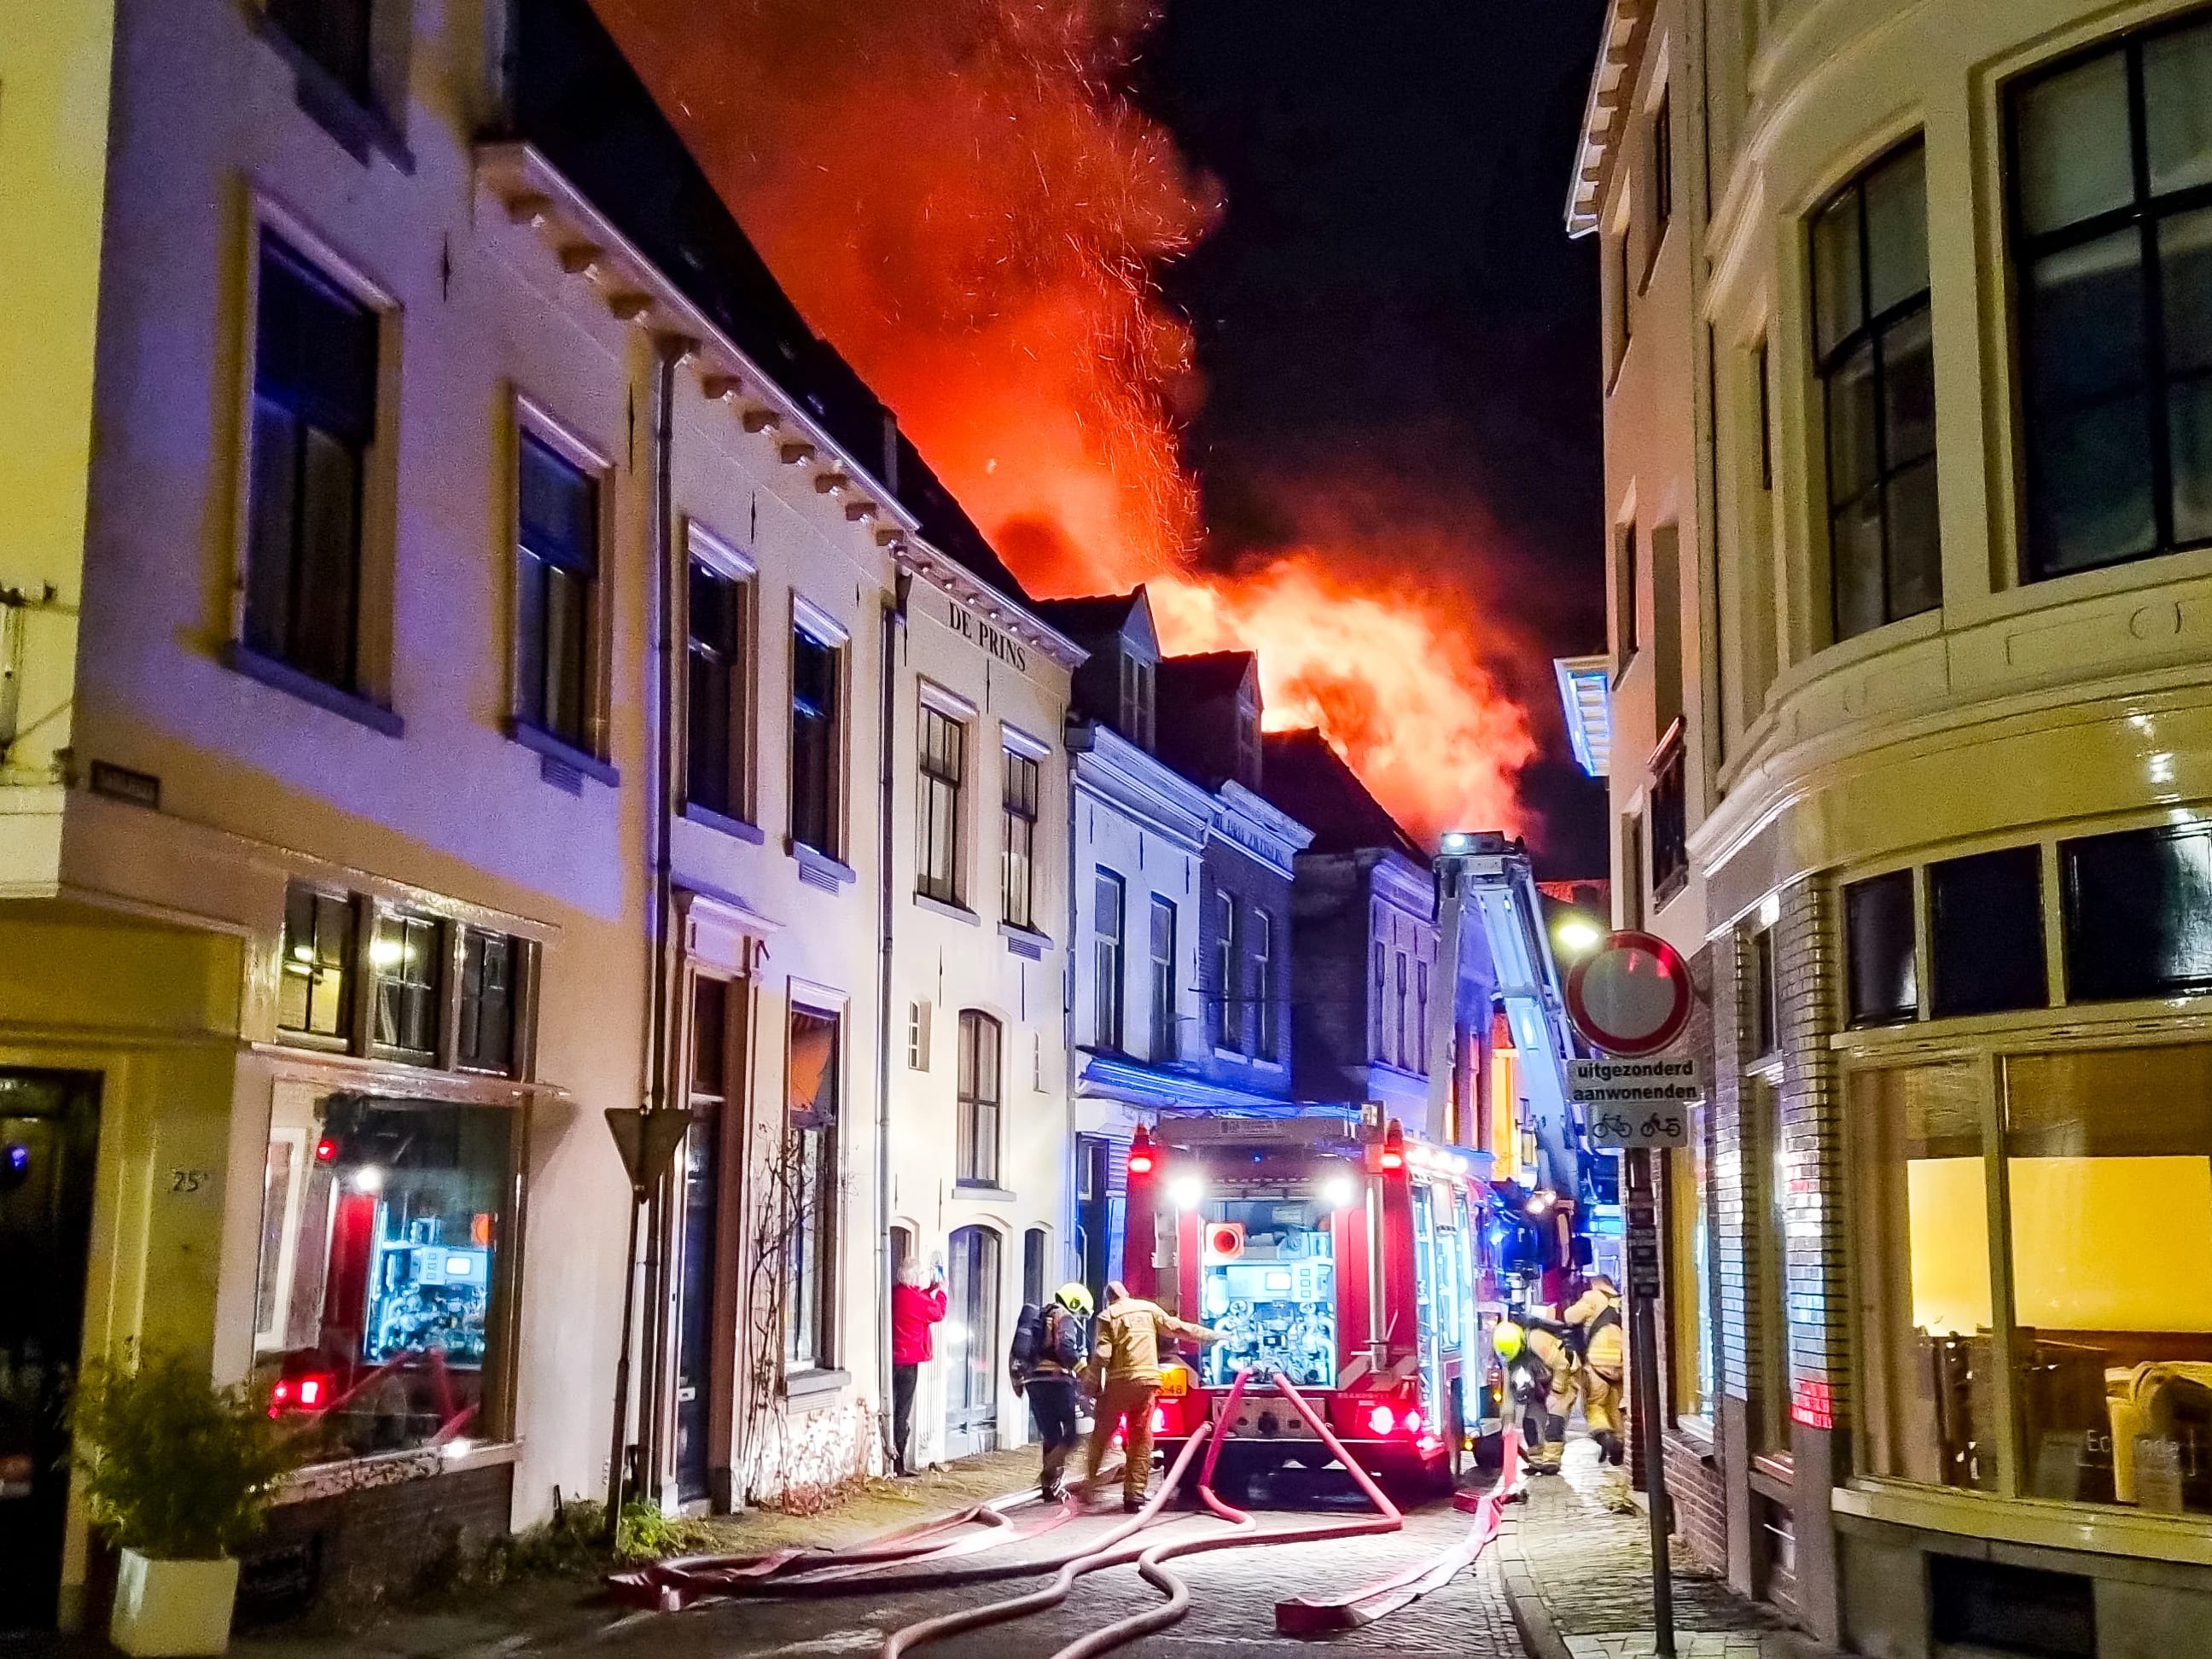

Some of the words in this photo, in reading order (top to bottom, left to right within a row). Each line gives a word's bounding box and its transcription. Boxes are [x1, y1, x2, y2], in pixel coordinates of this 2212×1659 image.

[949, 601, 972, 640] DE
[978, 620, 1026, 672] PRINS
[1579, 1059, 1694, 1081] uitgezonderd
[1573, 1083, 1697, 1101] aanwonenden
